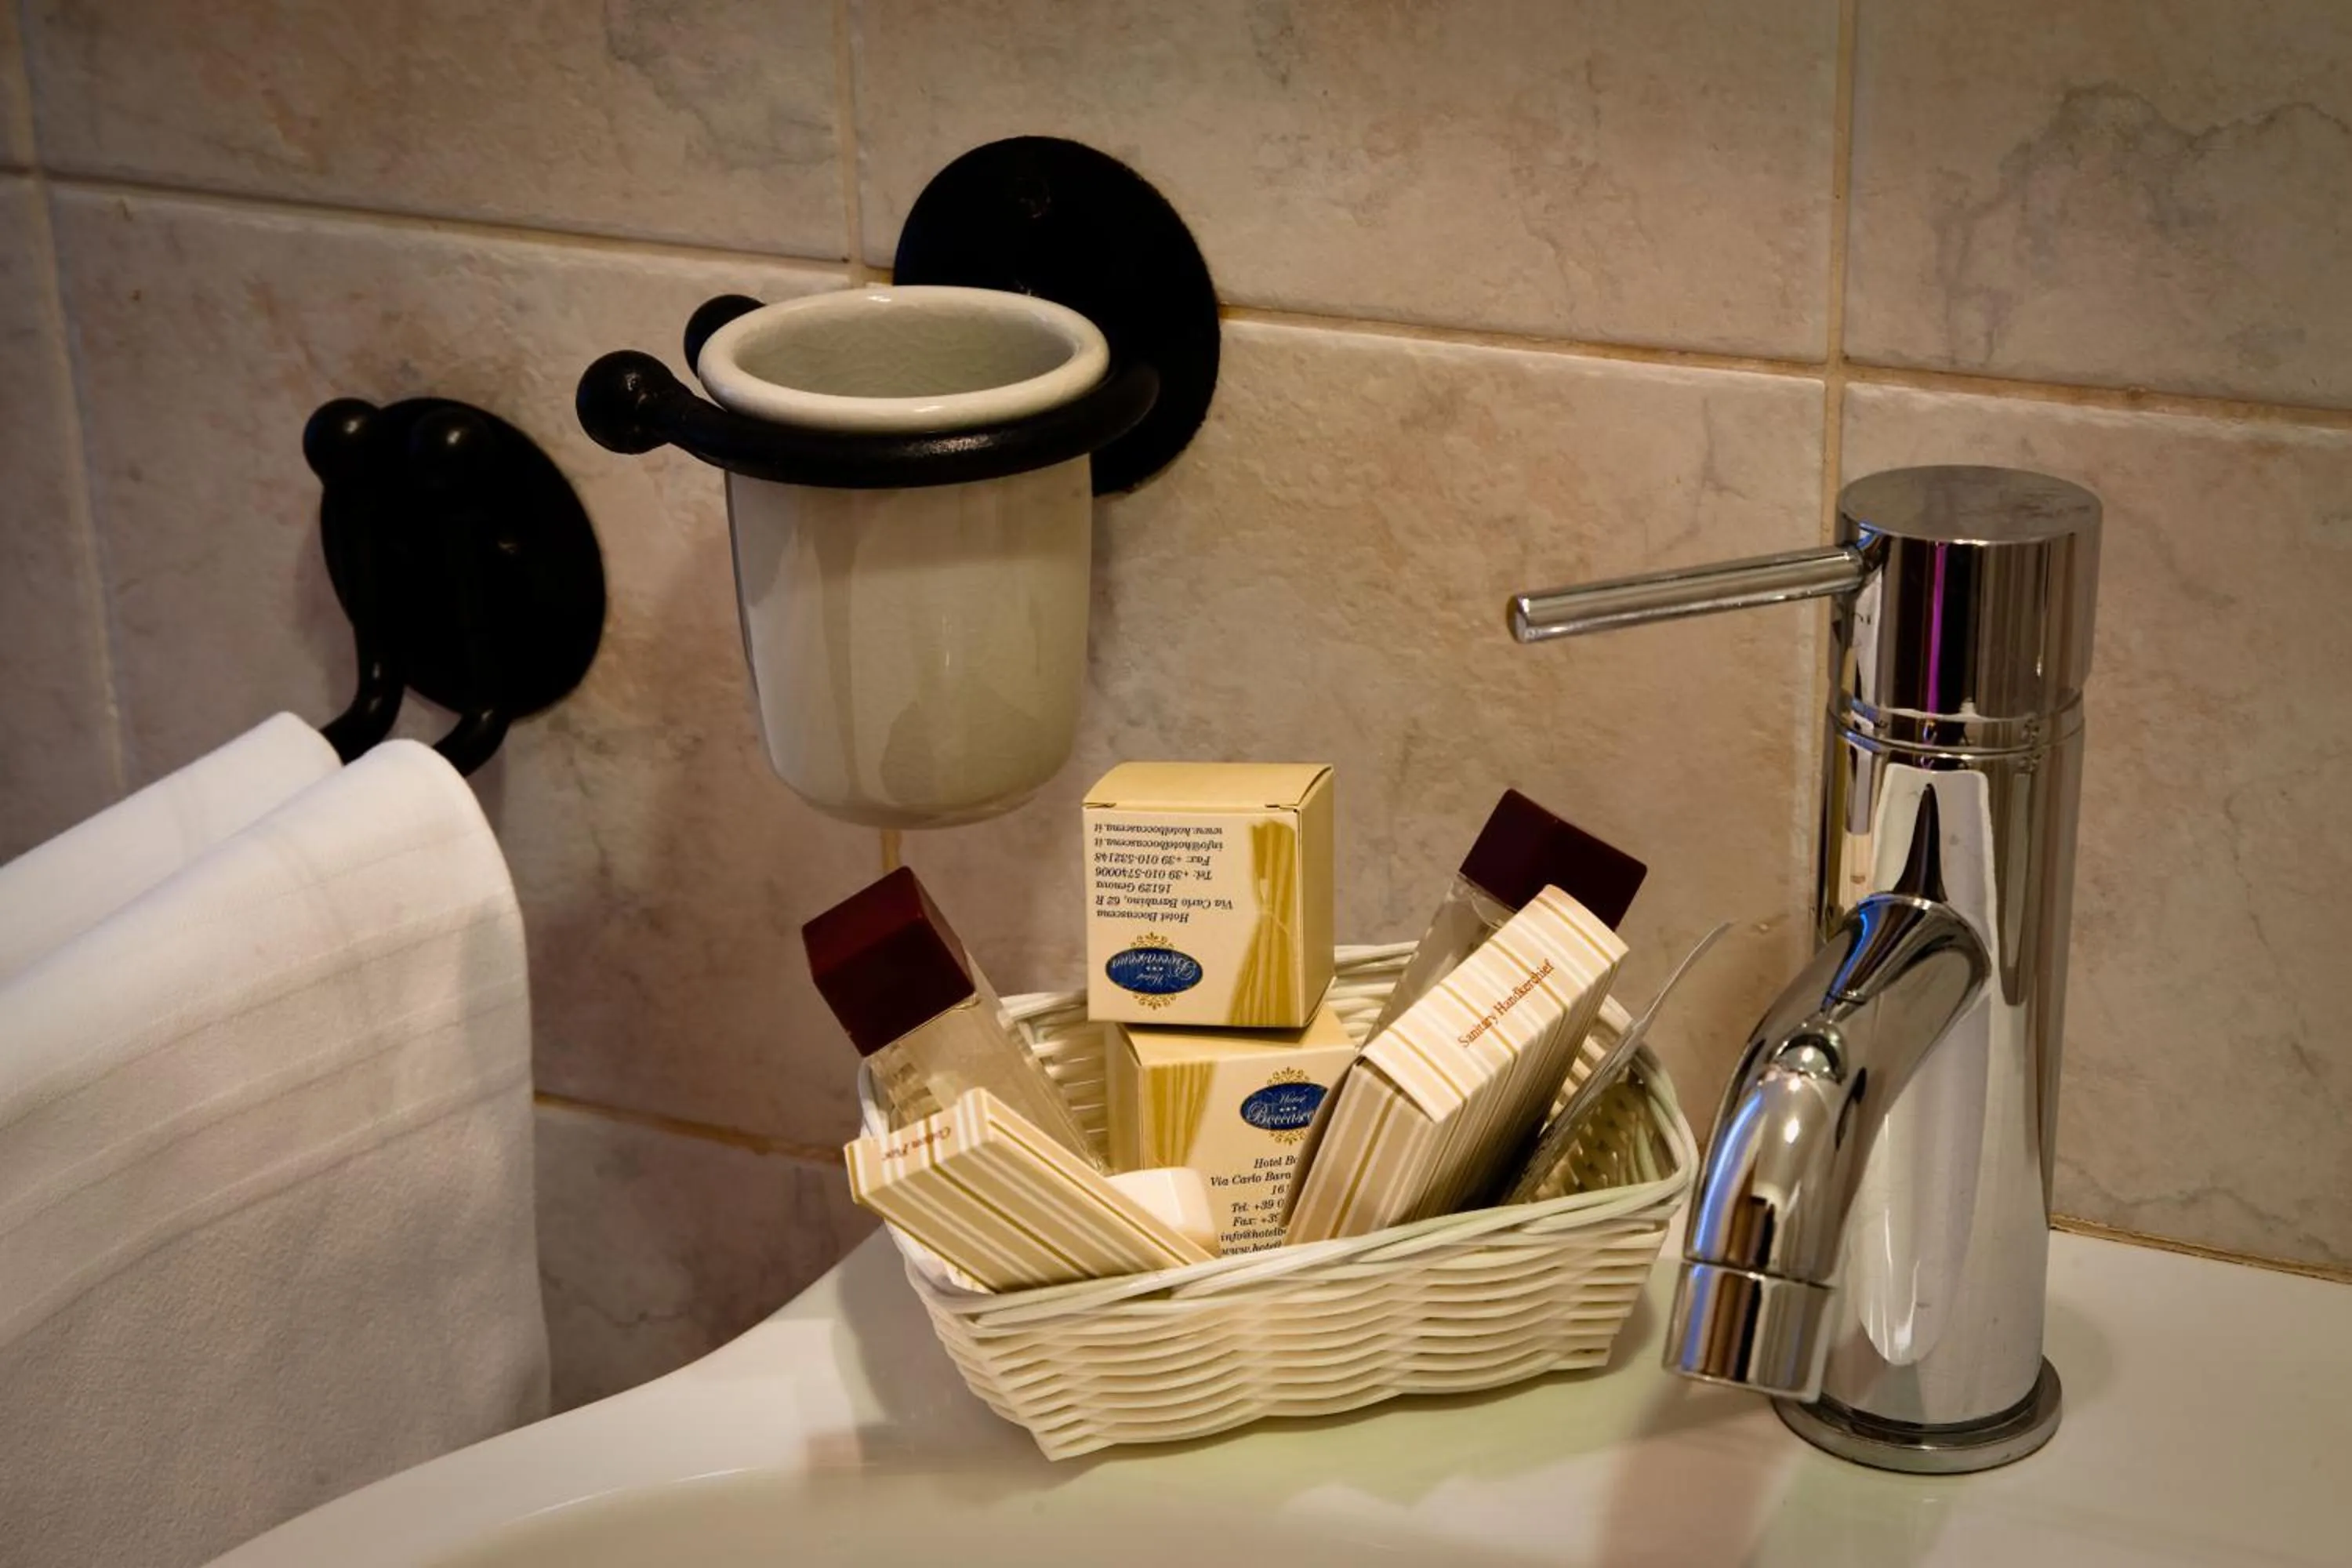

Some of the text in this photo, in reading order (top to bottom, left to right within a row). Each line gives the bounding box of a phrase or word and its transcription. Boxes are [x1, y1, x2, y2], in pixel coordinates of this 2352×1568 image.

[1096, 880, 1173, 895] 16129 Genova
[1095, 895, 1234, 910] Via Carlo Barabino, 62 R
[1096, 910, 1189, 924] Hotel Boccascena
[1458, 957, 1555, 1048] Sanitary Handkerchief
[1254, 1157, 1282, 1168] Hotel
[1210, 1177, 1229, 1186] Via
[1232, 1174, 1261, 1185] Carlo
